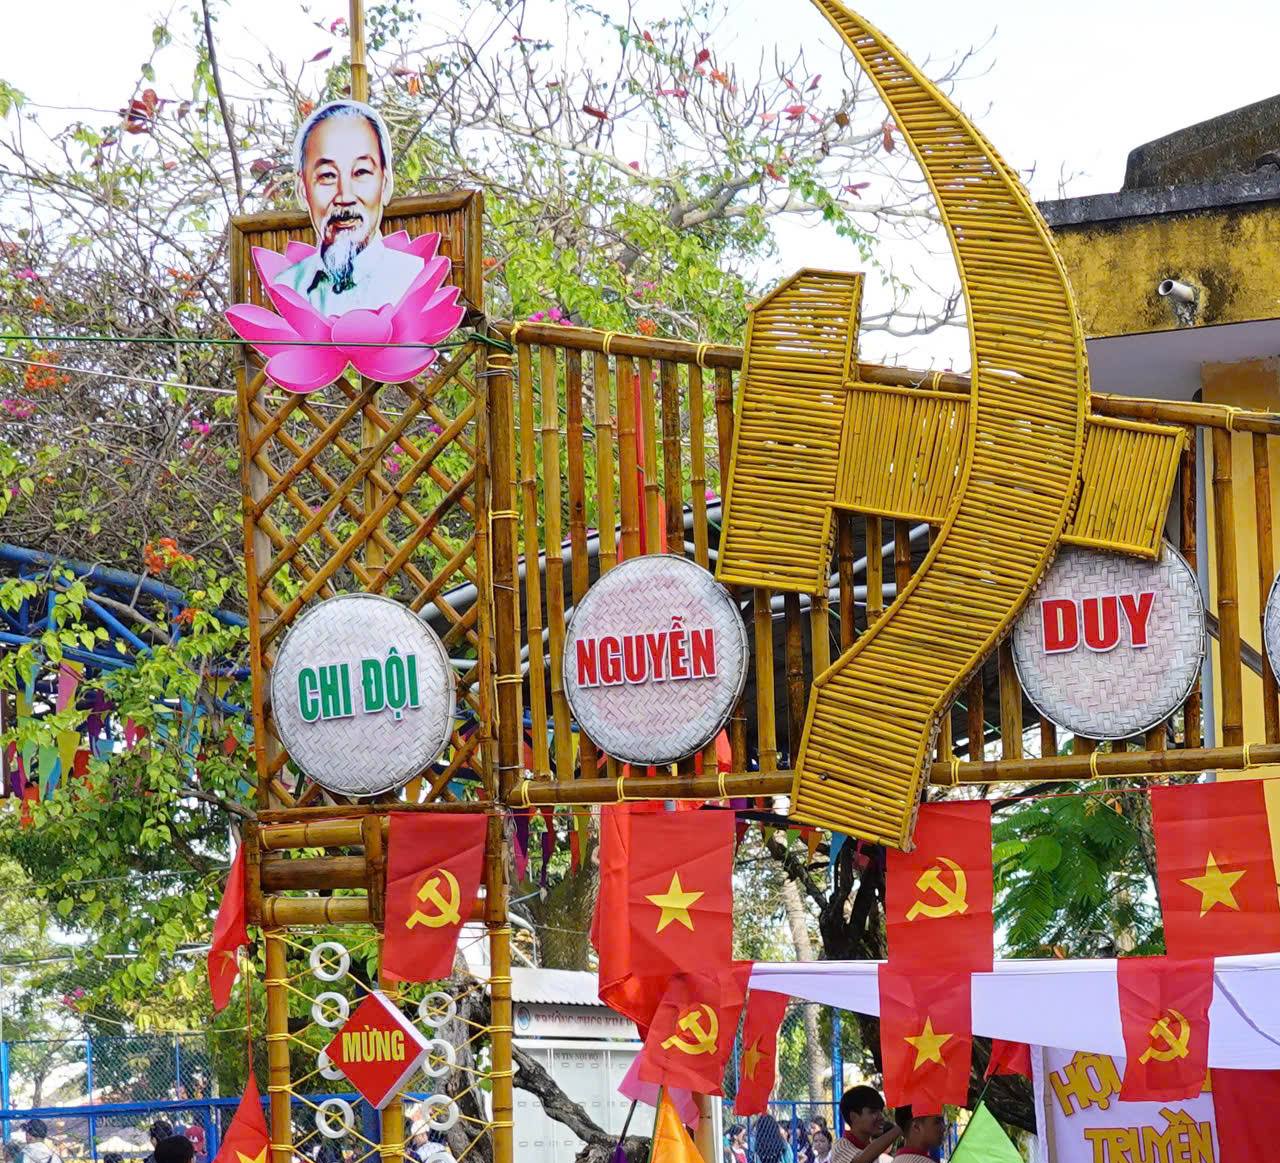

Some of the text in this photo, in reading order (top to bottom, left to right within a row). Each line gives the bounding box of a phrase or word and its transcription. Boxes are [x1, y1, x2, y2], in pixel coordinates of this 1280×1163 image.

[575, 616, 717, 688] NGUYỄN
[1041, 592, 1156, 655] DUY
[297, 646, 420, 723] CHI ĐỘI
[342, 1025, 405, 1062] MỪNG
[1049, 1051, 1123, 1117] HỘI
